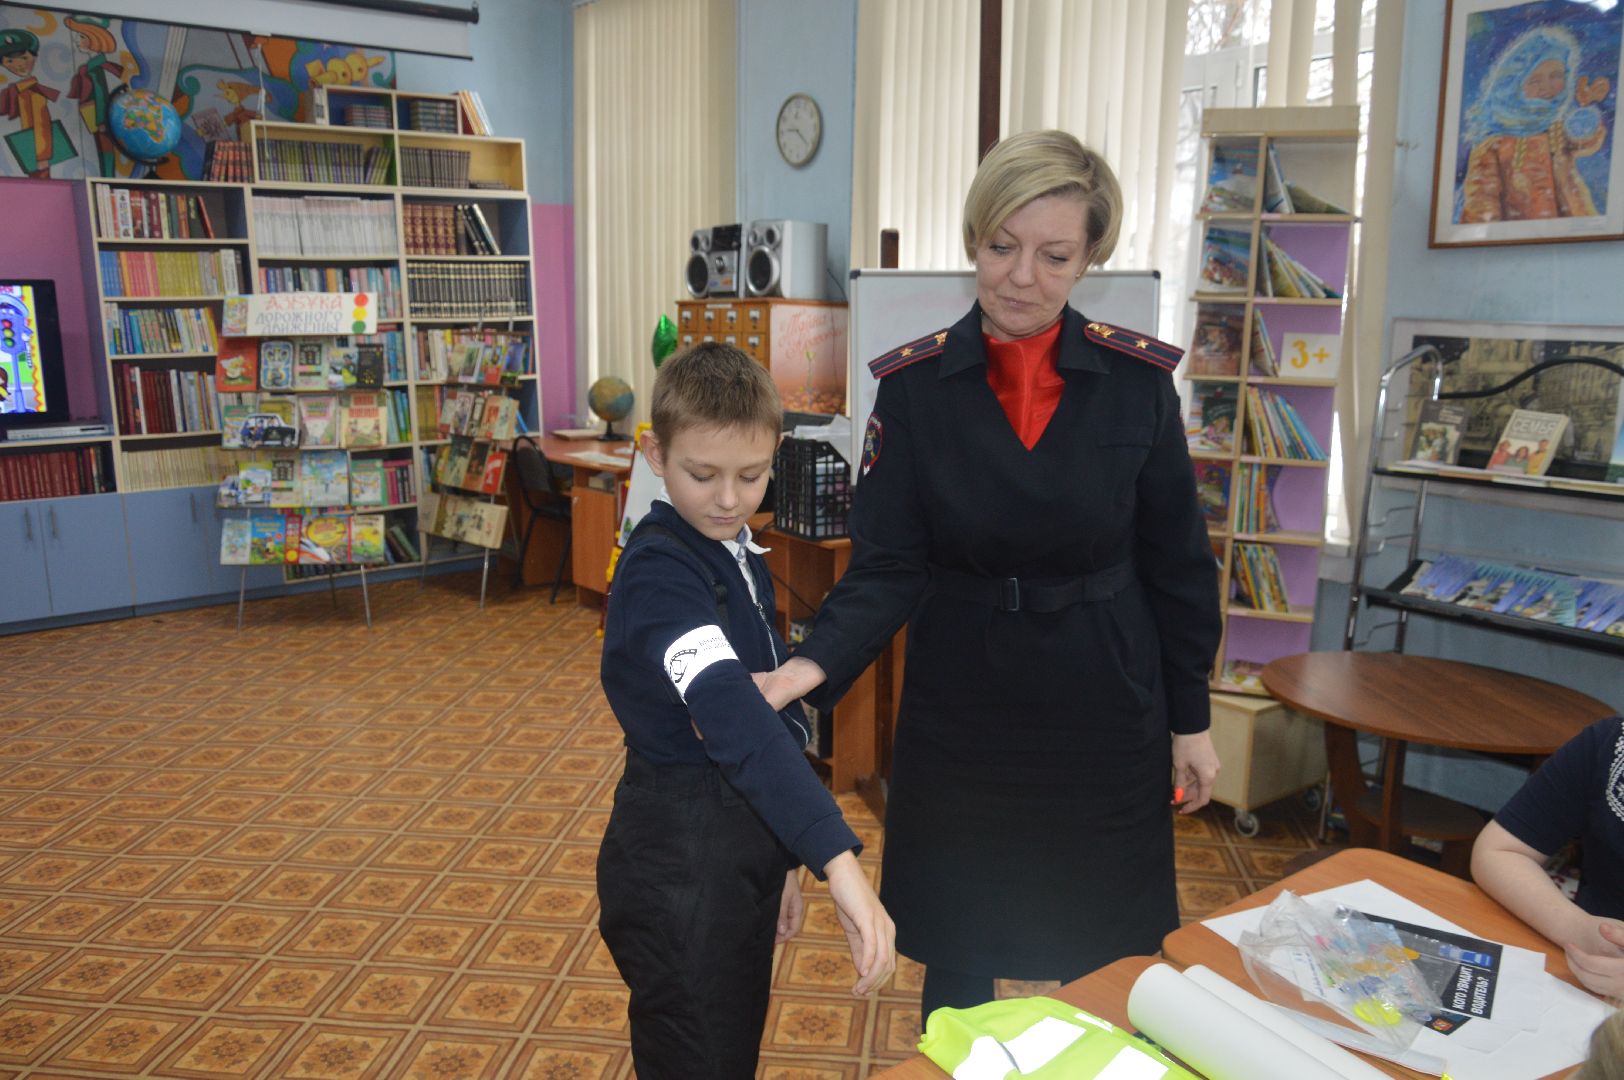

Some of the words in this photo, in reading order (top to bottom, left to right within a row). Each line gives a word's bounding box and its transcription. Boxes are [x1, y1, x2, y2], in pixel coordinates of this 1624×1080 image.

[256, 311, 343, 324] ДОРОЖНОГО
[1290, 340, 1330, 368] 3+
[1456, 966, 1473, 992] УВИДИТ
[1452, 992, 1467, 1010] КОГО
[1470, 976, 1489, 1014] ВОДИТЕЛЬ?
